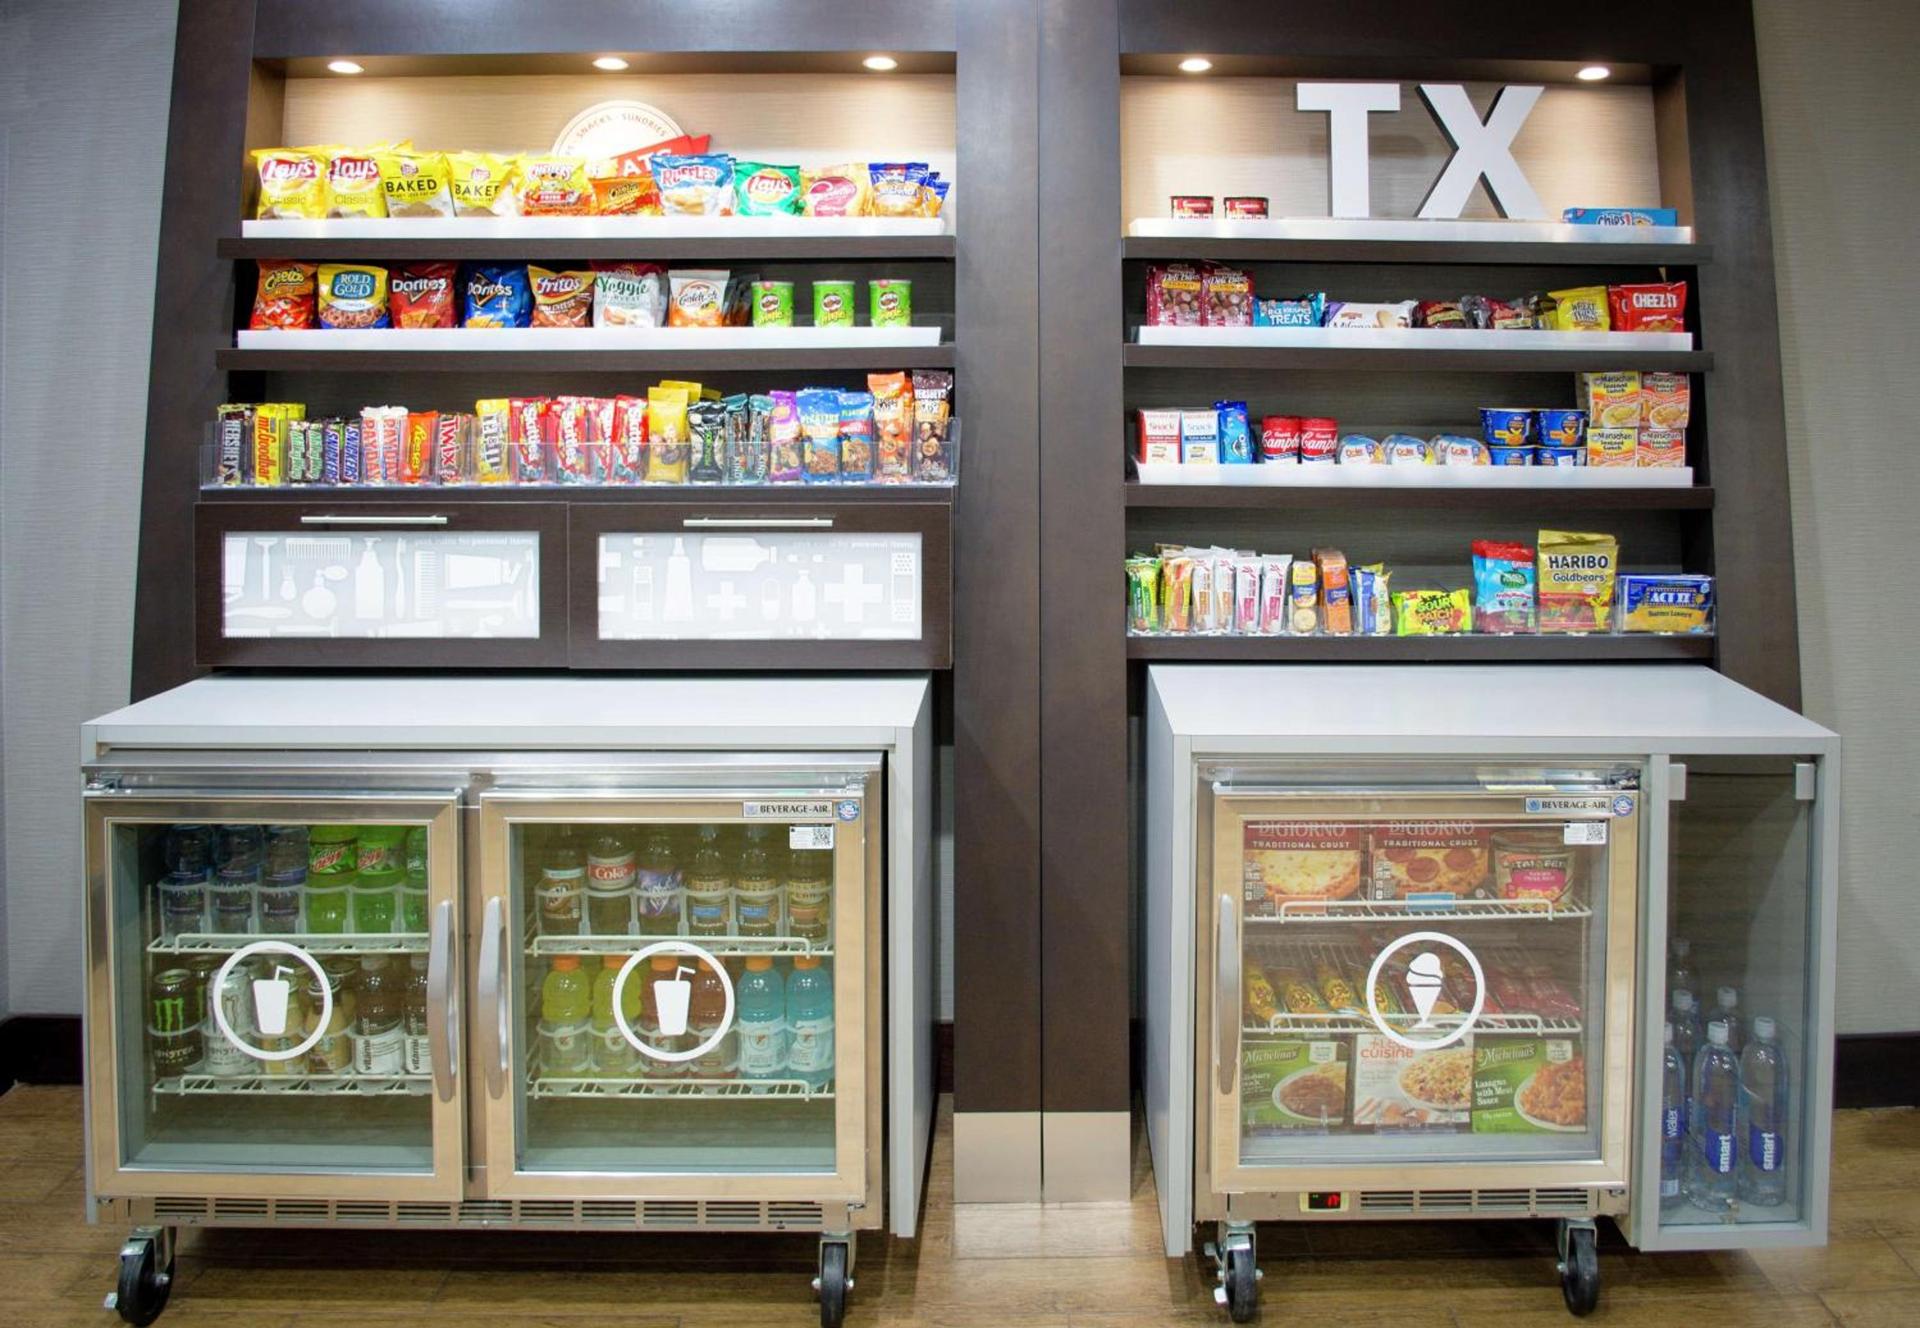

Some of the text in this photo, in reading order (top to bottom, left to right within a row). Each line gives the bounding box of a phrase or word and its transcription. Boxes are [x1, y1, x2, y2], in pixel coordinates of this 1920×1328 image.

[1297, 83, 1546, 219] TX
[265, 159, 314, 179] Lay's
[331, 157, 377, 180] Lay's
[385, 179, 438, 193] BAKED
[749, 176, 793, 195] Lay's
[340, 273, 371, 284] ROLD
[334, 283, 372, 296] GOLD
[392, 278, 447, 293] Doritos
[597, 275, 649, 296] Veggie
[1269, 314, 1312, 326] TREATS
[1600, 374, 1636, 384] Maruchan
[1651, 375, 1686, 385] Maruchan
[1598, 431, 1633, 441] Maruchan
[1647, 432, 1681, 442] Maruchan
[325, 430, 340, 482] SNICKERS
[344, 426, 359, 481] SNICKERS
[1548, 555, 1609, 570] HARIBO
[1552, 572, 1605, 584] Goldbears
[1650, 592, 1676, 604] ACT
[1417, 598, 1453, 612] SOUR
[759, 805, 828, 814] BEVERAGE-AIR
[1541, 800, 1608, 810] BEVERAGE-AIR
[1252, 840, 1350, 849] TRADITIONAL CRUST
[1383, 839, 1479, 848] TRADITIONAL CRUST
[594, 866, 629, 881] Coke
[1360, 1047, 1414, 1059] cuisine
[1476, 1087, 1494, 1097] with
[1719, 1134, 1731, 1173] smart
[1763, 1132, 1775, 1171] smart
